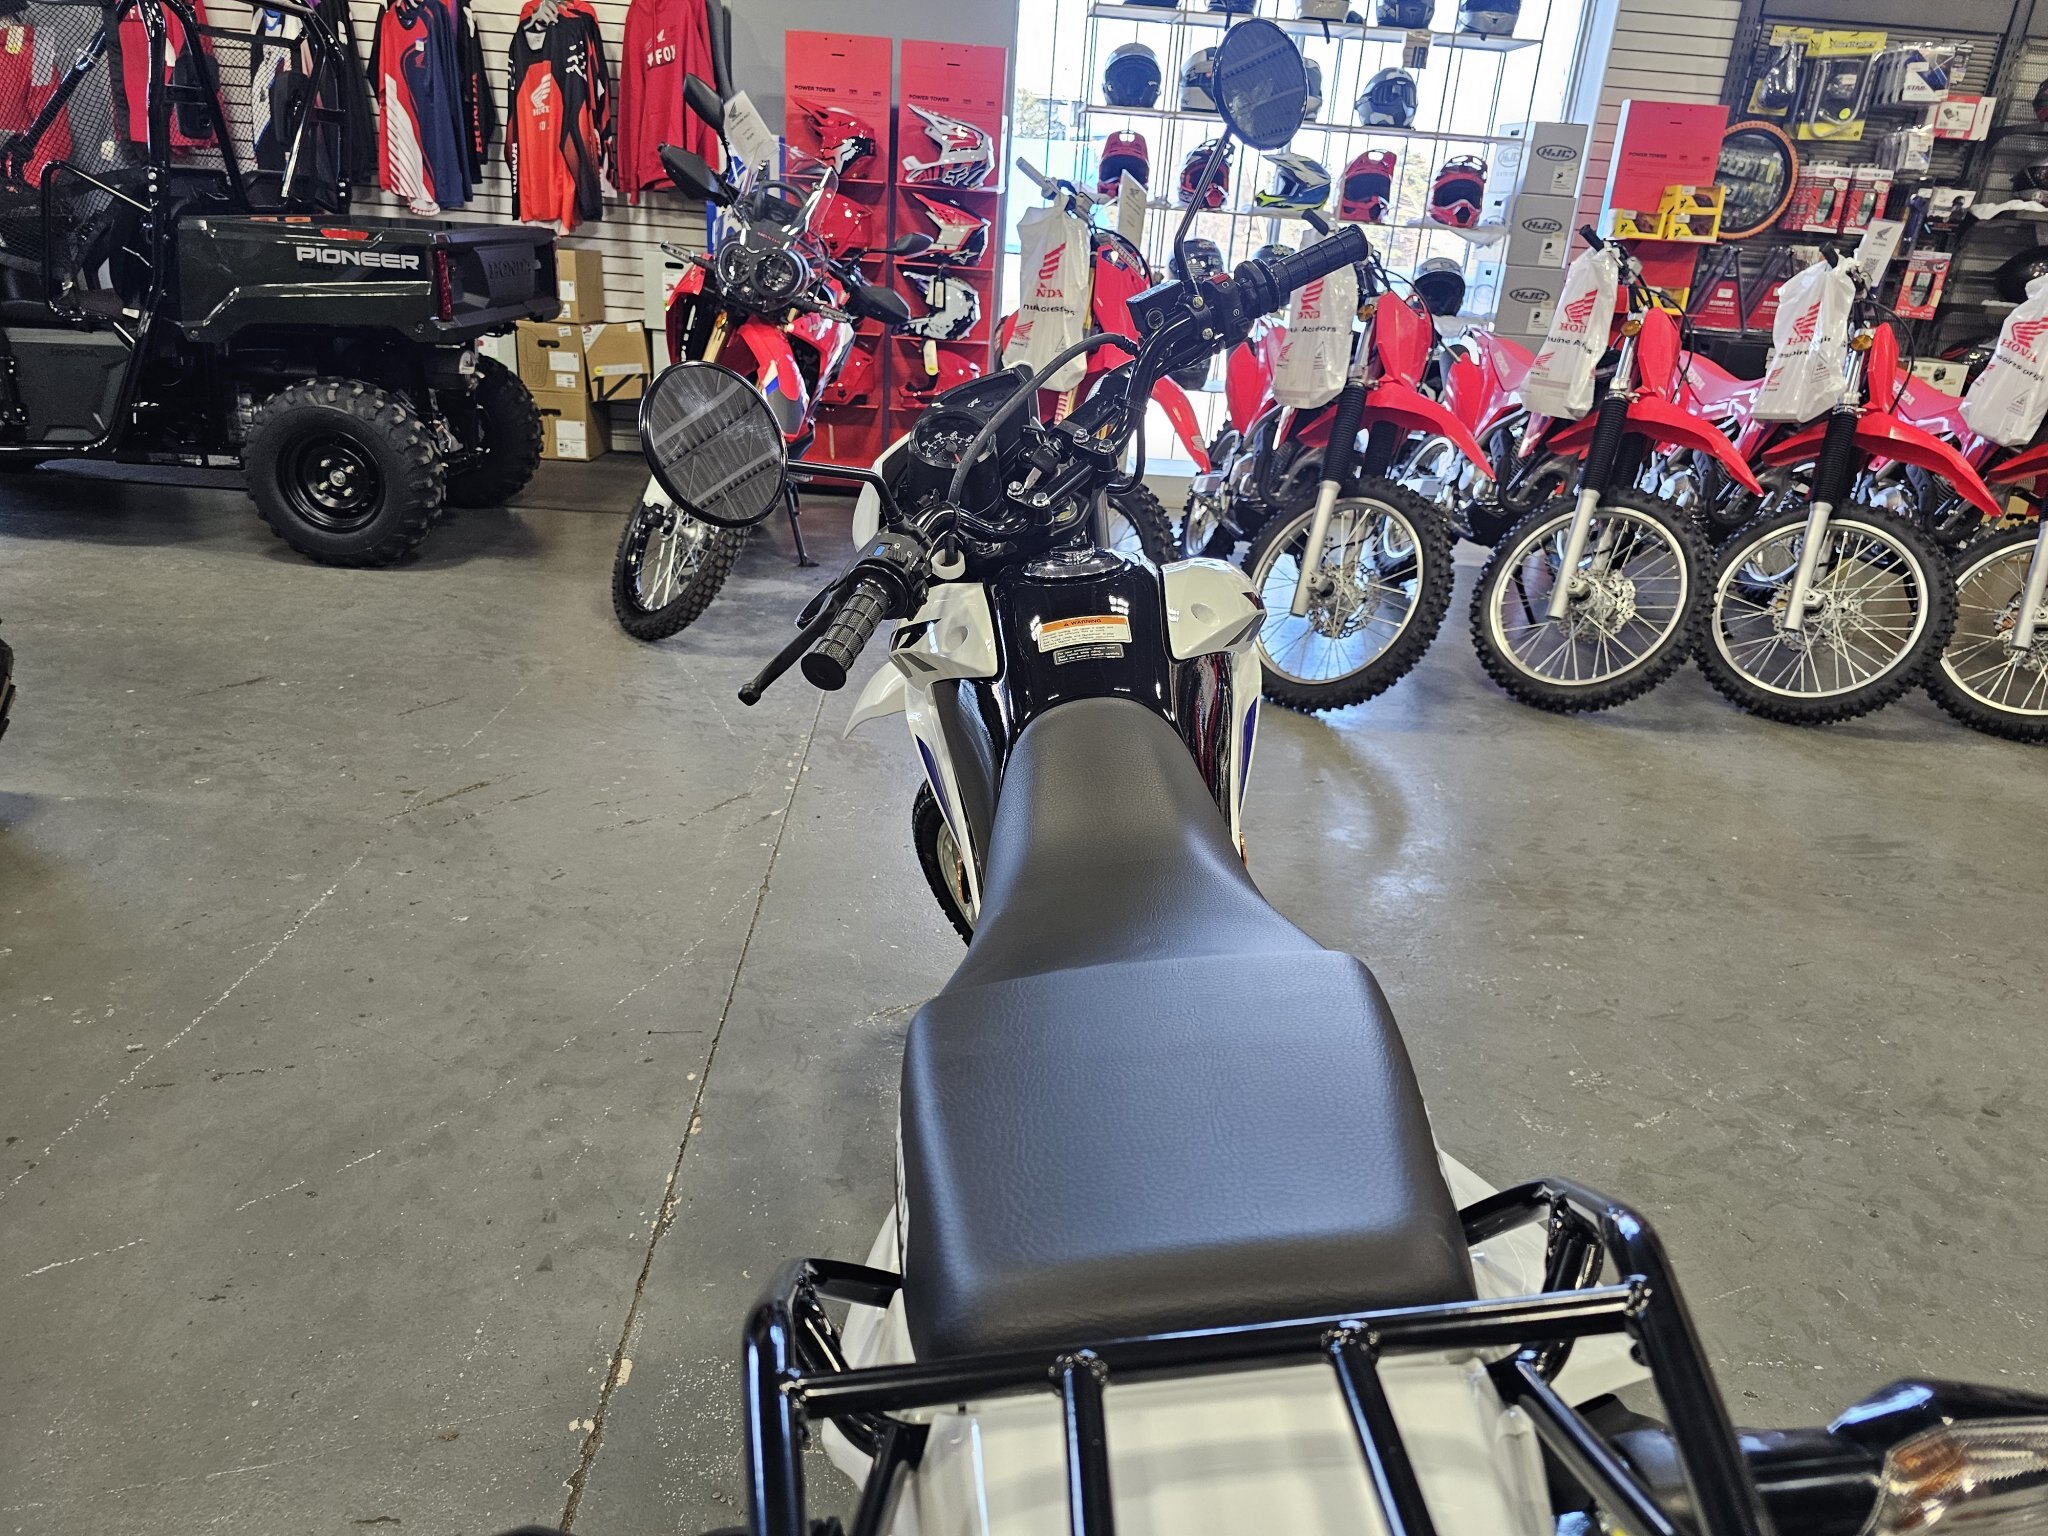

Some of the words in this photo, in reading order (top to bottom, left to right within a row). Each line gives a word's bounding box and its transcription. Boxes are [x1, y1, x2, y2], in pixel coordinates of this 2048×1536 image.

[794, 84, 815, 92] POWER
[908, 93, 929, 101] POWER
[1541, 147, 1574, 159] HJC
[1526, 220, 1558, 232] HJC
[296, 246, 420, 271] PIONEER
[1514, 290, 1546, 302] HJC
[1071, 618, 1102, 627] WARNING
